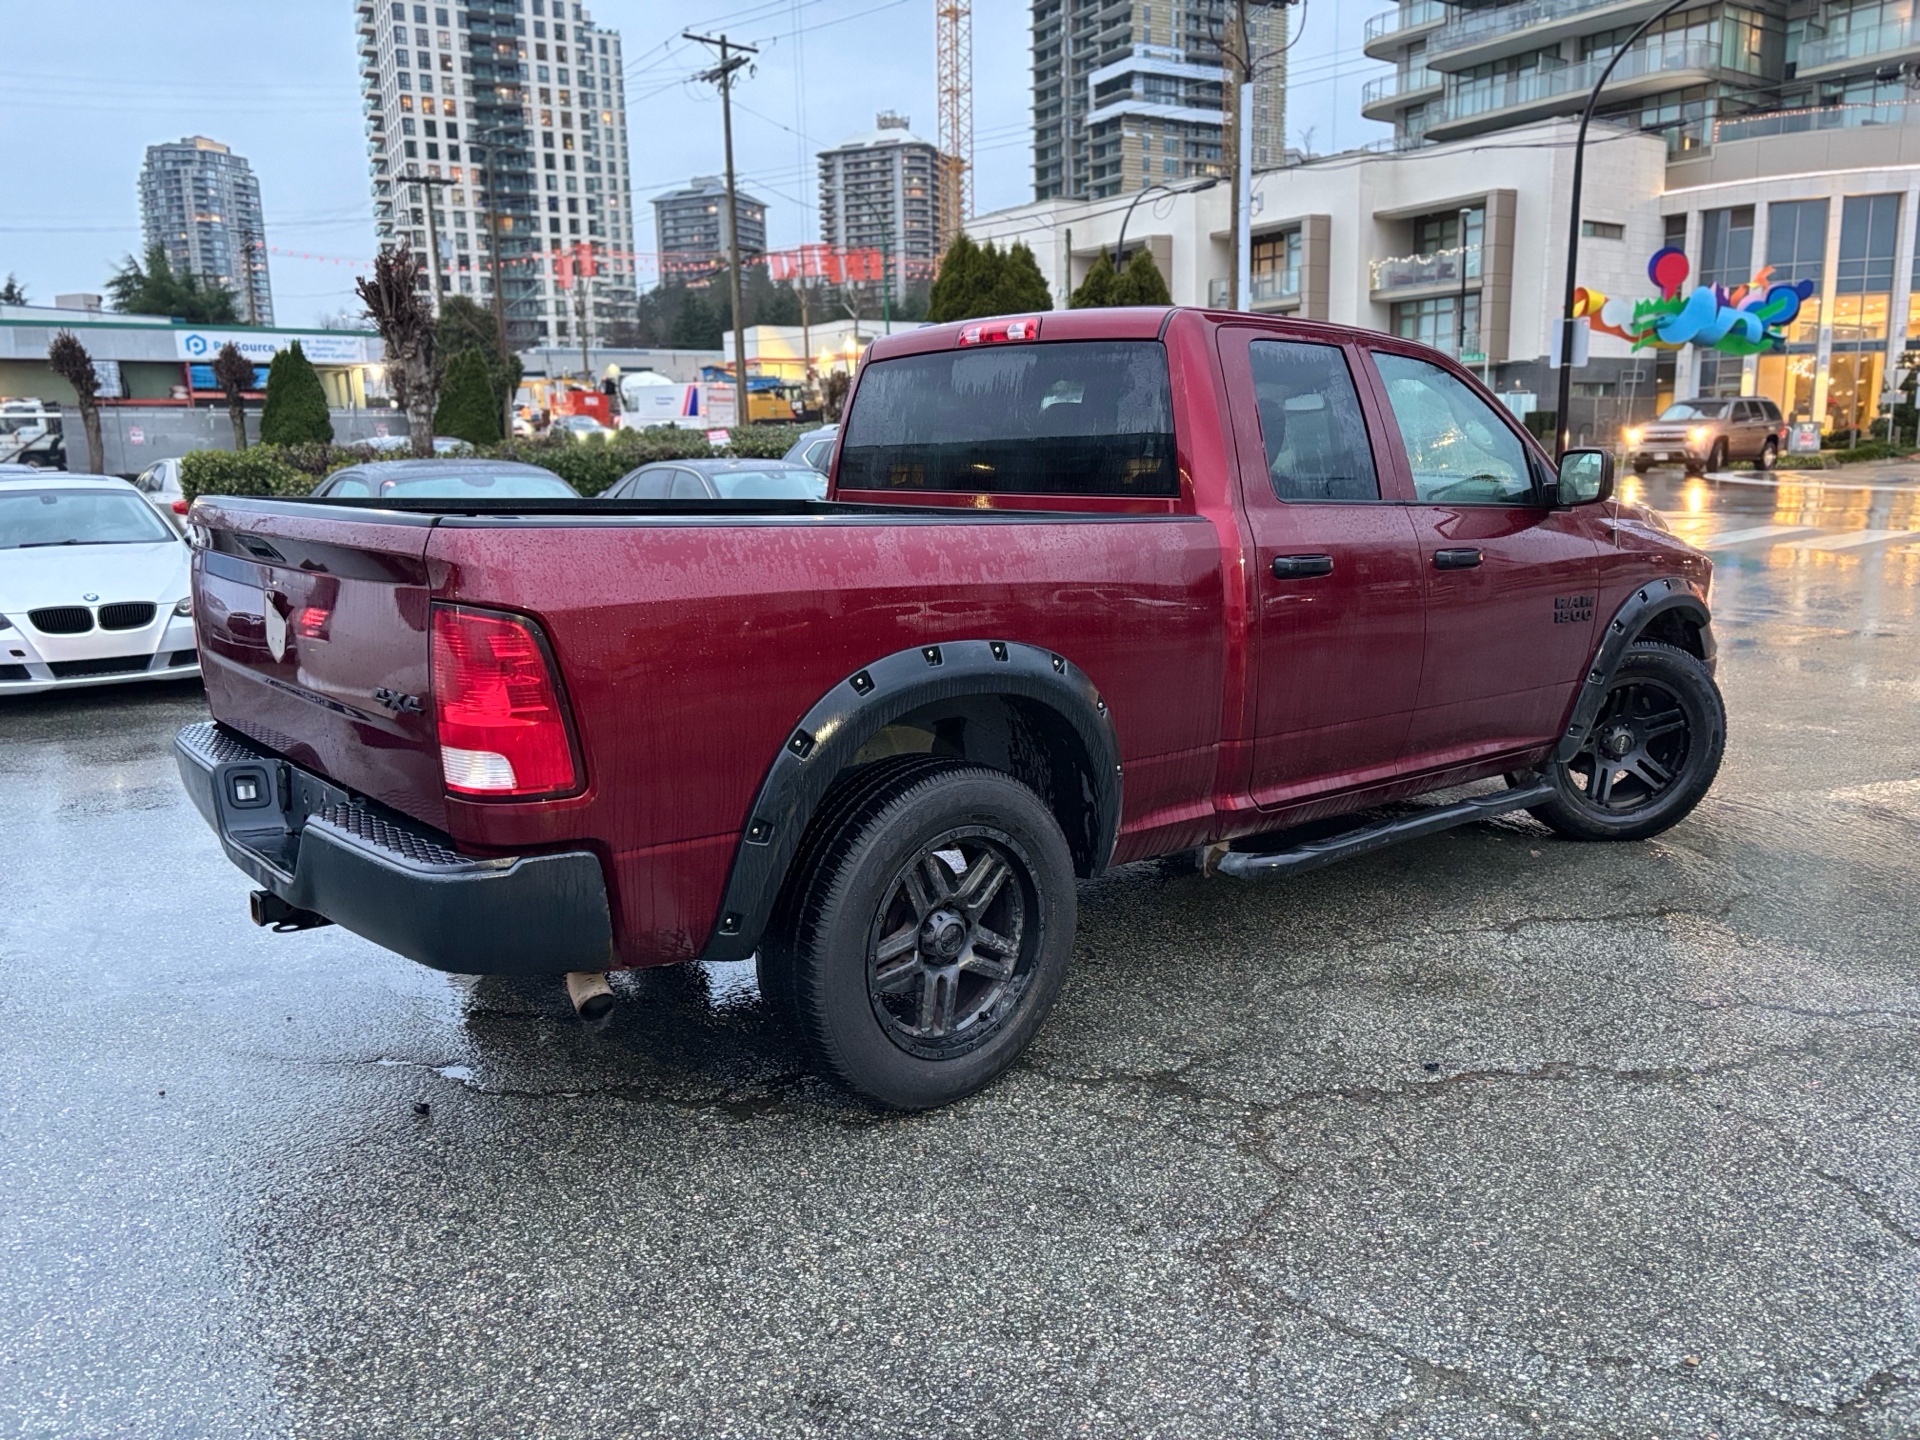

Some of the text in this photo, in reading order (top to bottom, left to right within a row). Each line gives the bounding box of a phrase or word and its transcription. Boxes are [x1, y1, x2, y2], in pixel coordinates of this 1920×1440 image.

[213, 340, 275, 353] PSource
[1554, 595, 1595, 610] RAM
[1554, 609, 1593, 624] 1500
